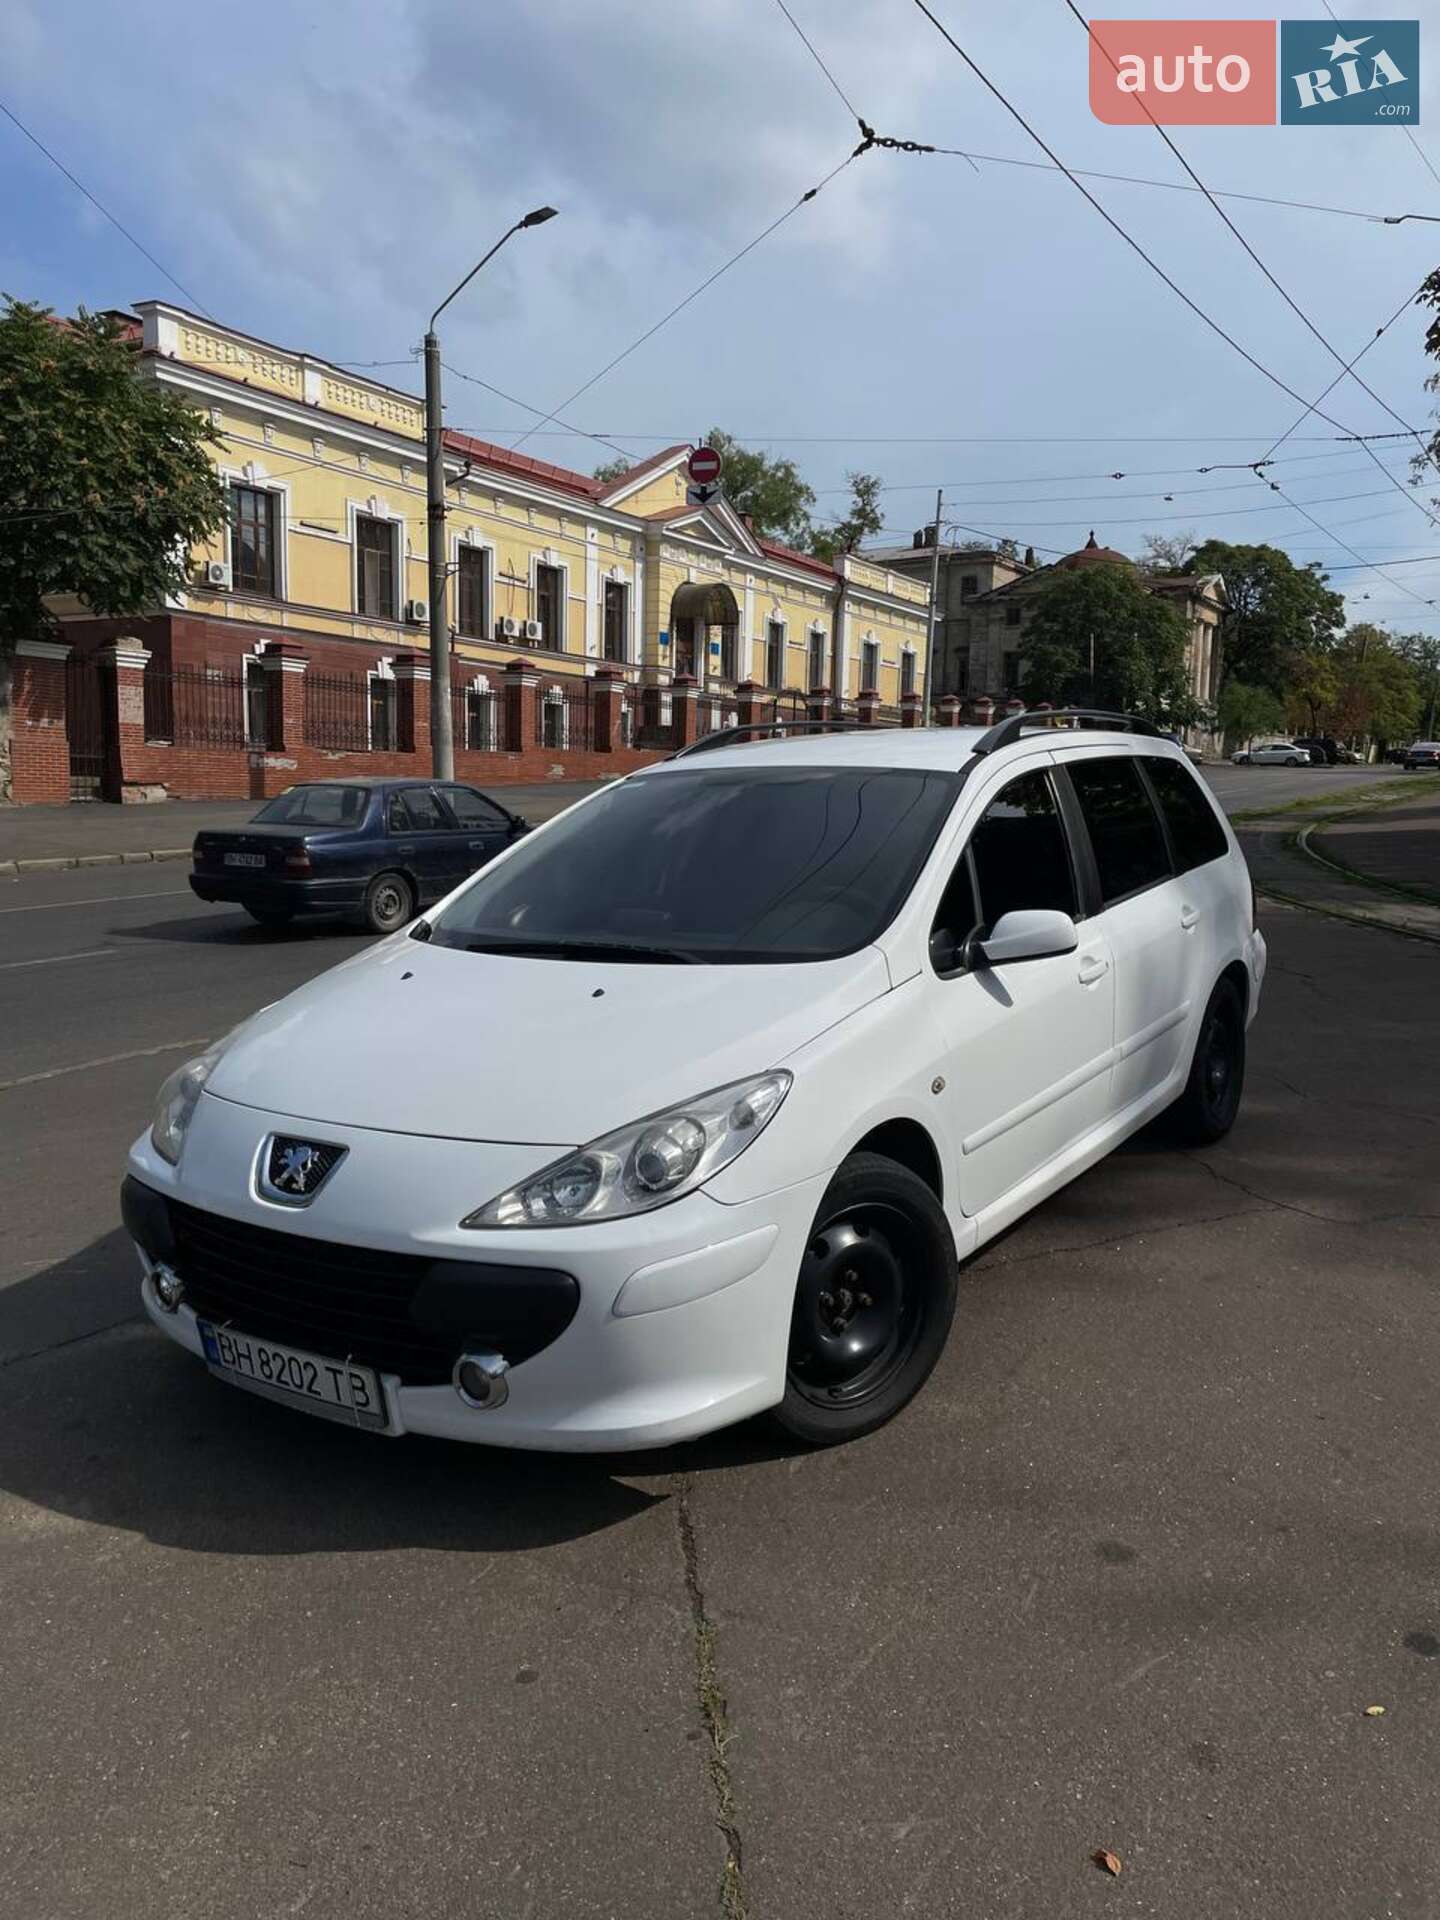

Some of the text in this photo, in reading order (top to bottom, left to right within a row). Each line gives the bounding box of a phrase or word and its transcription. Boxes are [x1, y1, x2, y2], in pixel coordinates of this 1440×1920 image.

[217, 1331, 371, 1408] BH 8202 TB
